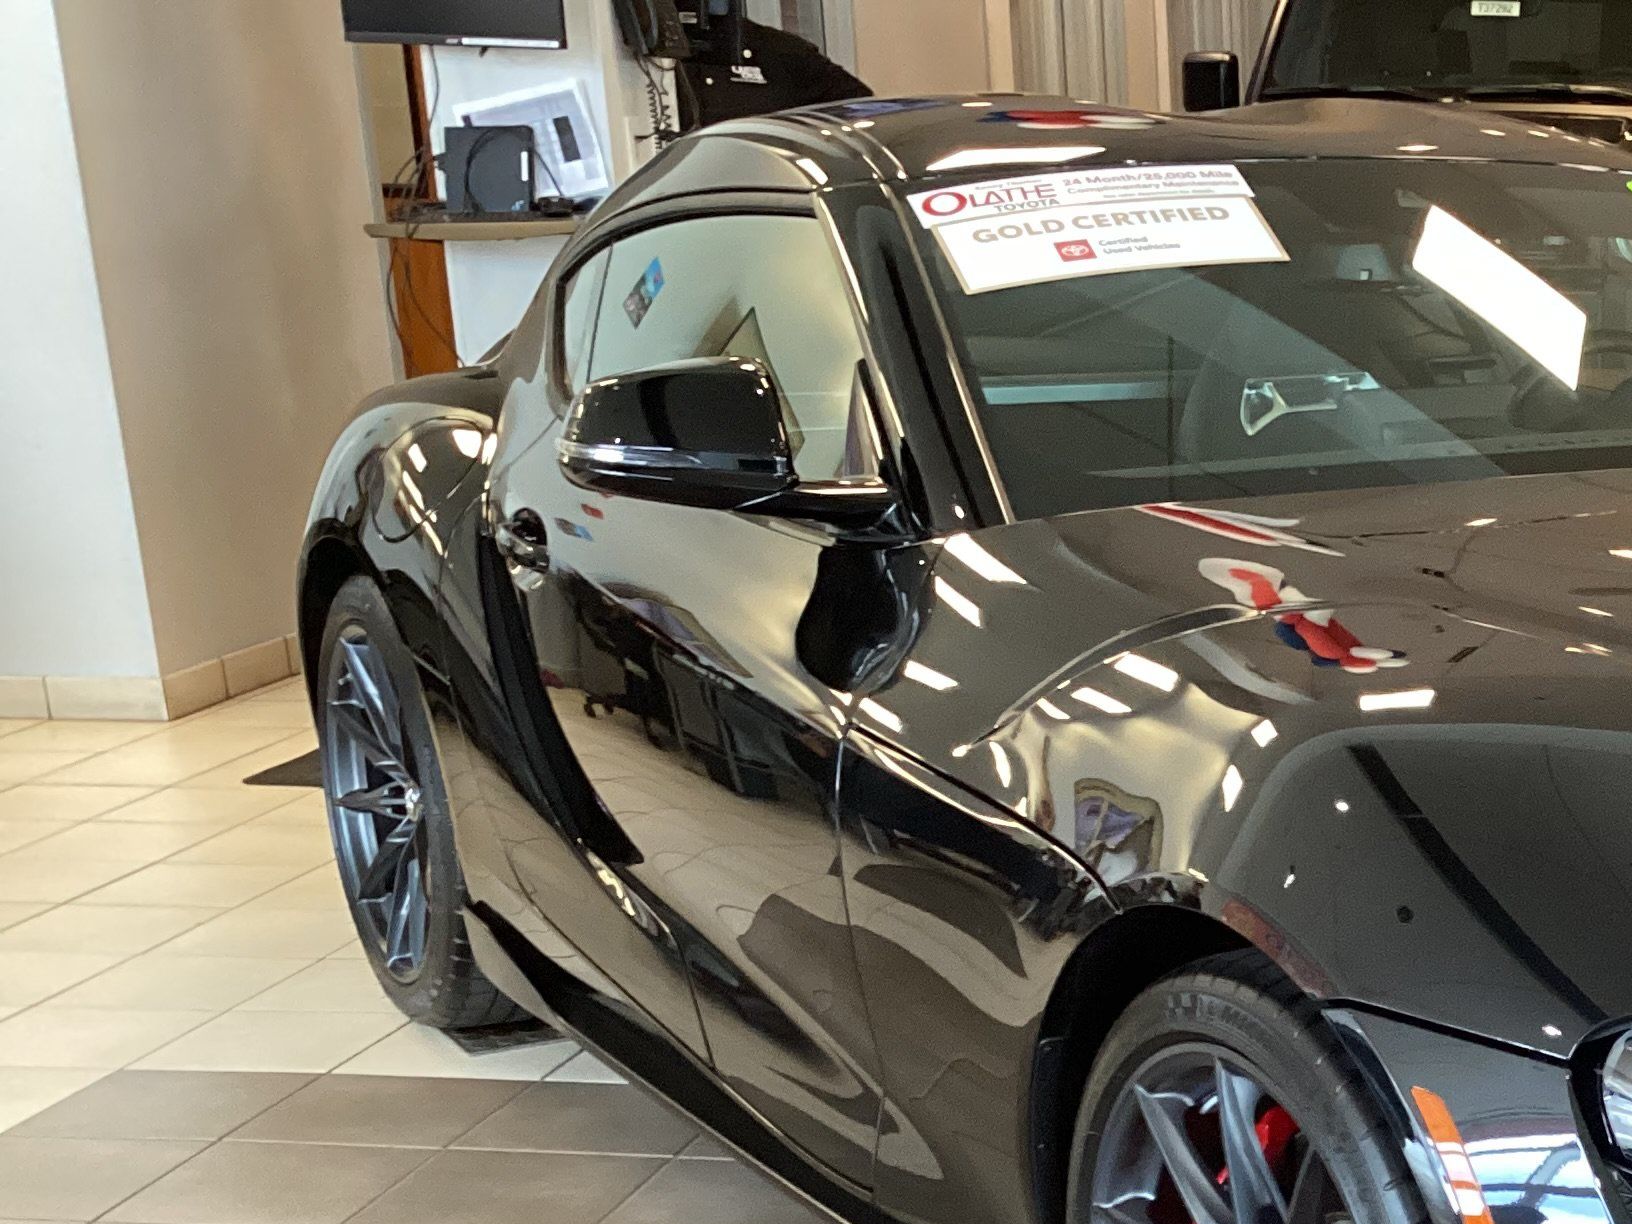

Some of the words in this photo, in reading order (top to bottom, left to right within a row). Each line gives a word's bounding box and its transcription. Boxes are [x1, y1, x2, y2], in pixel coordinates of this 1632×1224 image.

[1062, 178, 1082, 187] 24
[1200, 170, 1233, 179] Mile
[1067, 182, 1160, 195] Complimentary
[1162, 179, 1240, 188] Maintenance
[994, 198, 1060, 212] TOYOTA
[972, 219, 1065, 245] GOLD
[1072, 206, 1230, 231] CERTIFIED
[1098, 236, 1148, 246] Certified
[1103, 246, 1133, 254] Used
